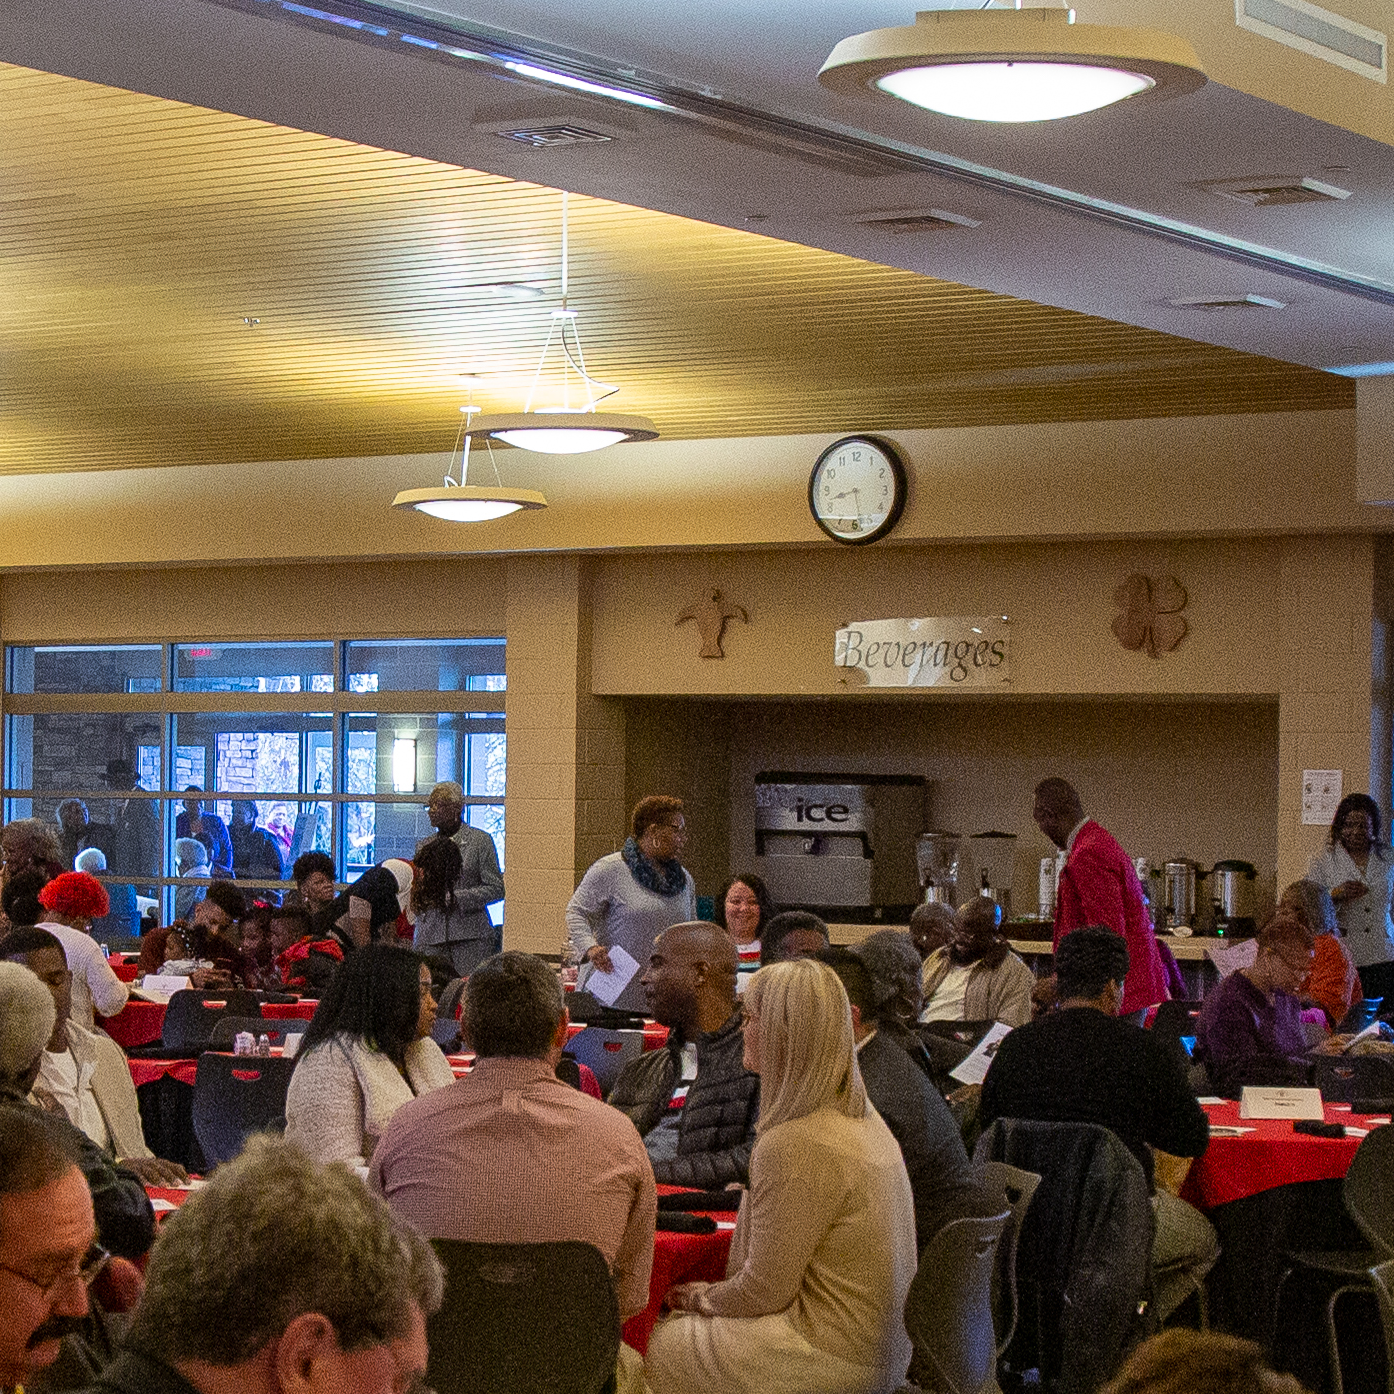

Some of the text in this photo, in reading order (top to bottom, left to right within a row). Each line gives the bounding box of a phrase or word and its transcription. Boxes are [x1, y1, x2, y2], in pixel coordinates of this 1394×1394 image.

[839, 456, 846, 466] 11
[852, 451, 861, 462] 12
[827, 468, 836, 479] 10
[879, 468, 886, 479] 2
[824, 485, 830, 497] 9
[883, 485, 889, 496] 3
[878, 502, 884, 513] 4
[841, 630, 1006, 683] Beverages
[796, 797, 849, 823] ice
